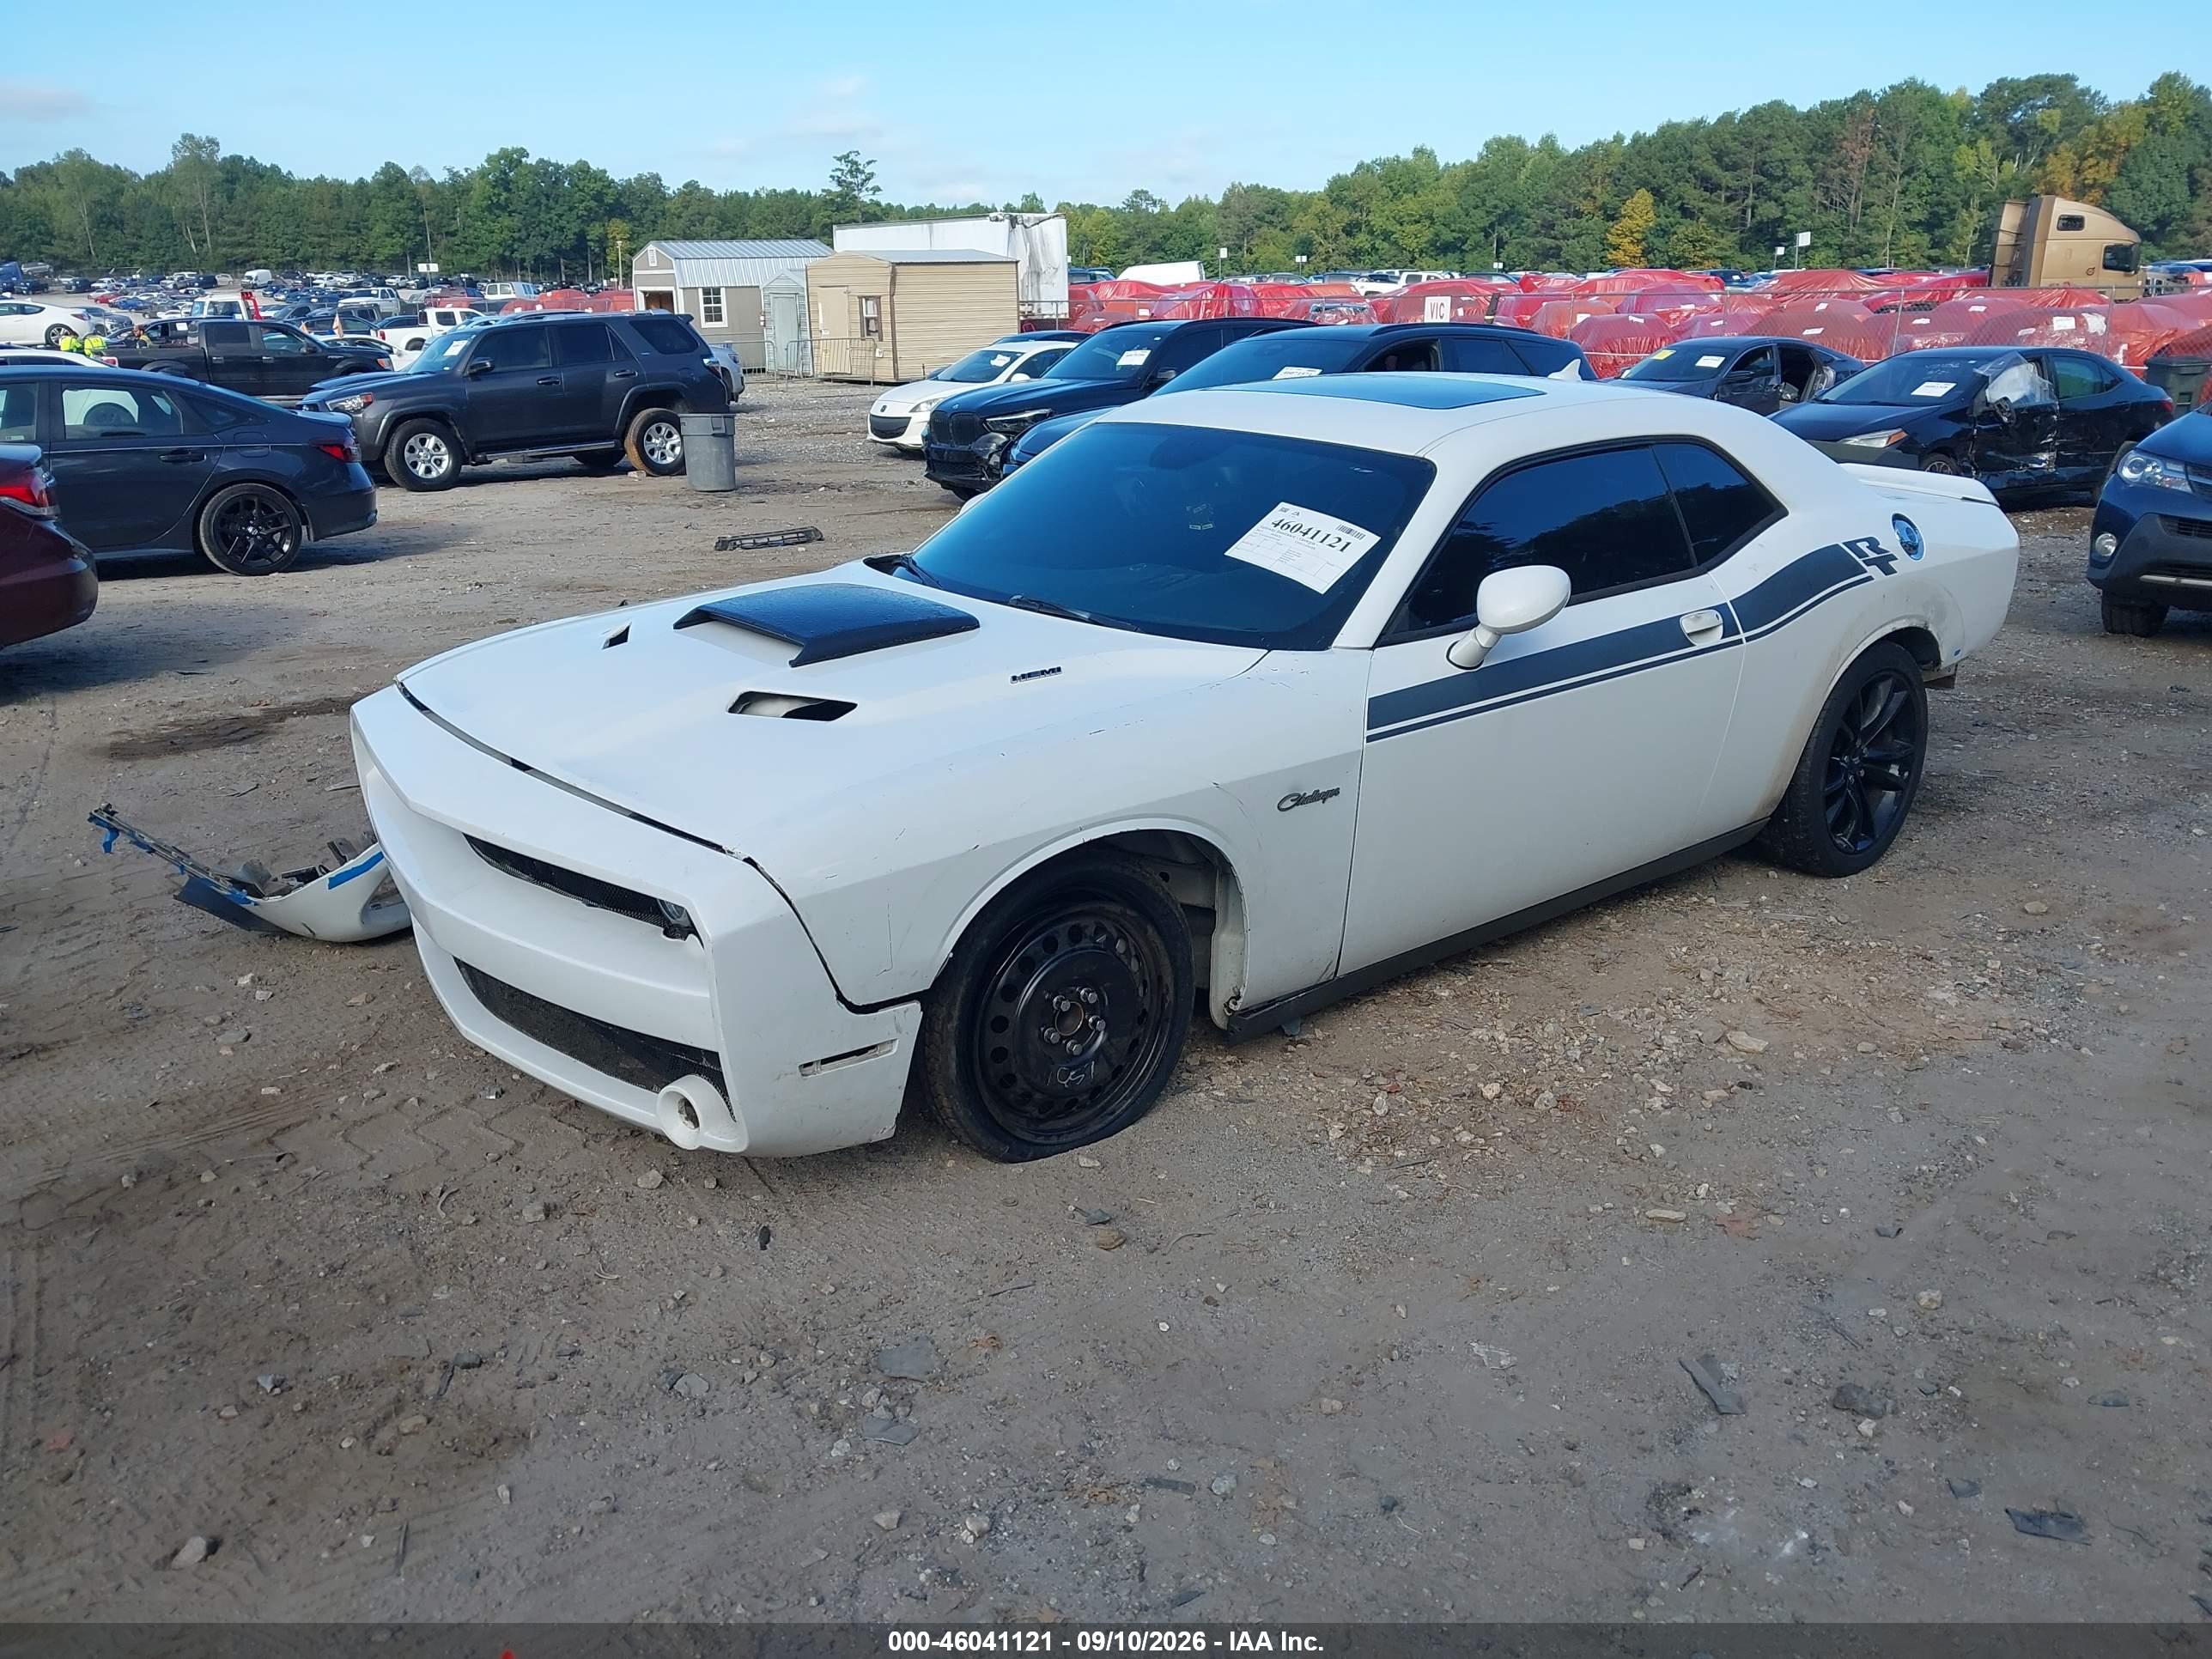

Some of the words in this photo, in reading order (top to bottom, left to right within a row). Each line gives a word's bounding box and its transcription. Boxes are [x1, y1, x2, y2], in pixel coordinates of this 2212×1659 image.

[1431, 302, 1445, 319] VIC
[1271, 519, 1353, 553] 46041121
[1011, 666, 1061, 684] HEMI
